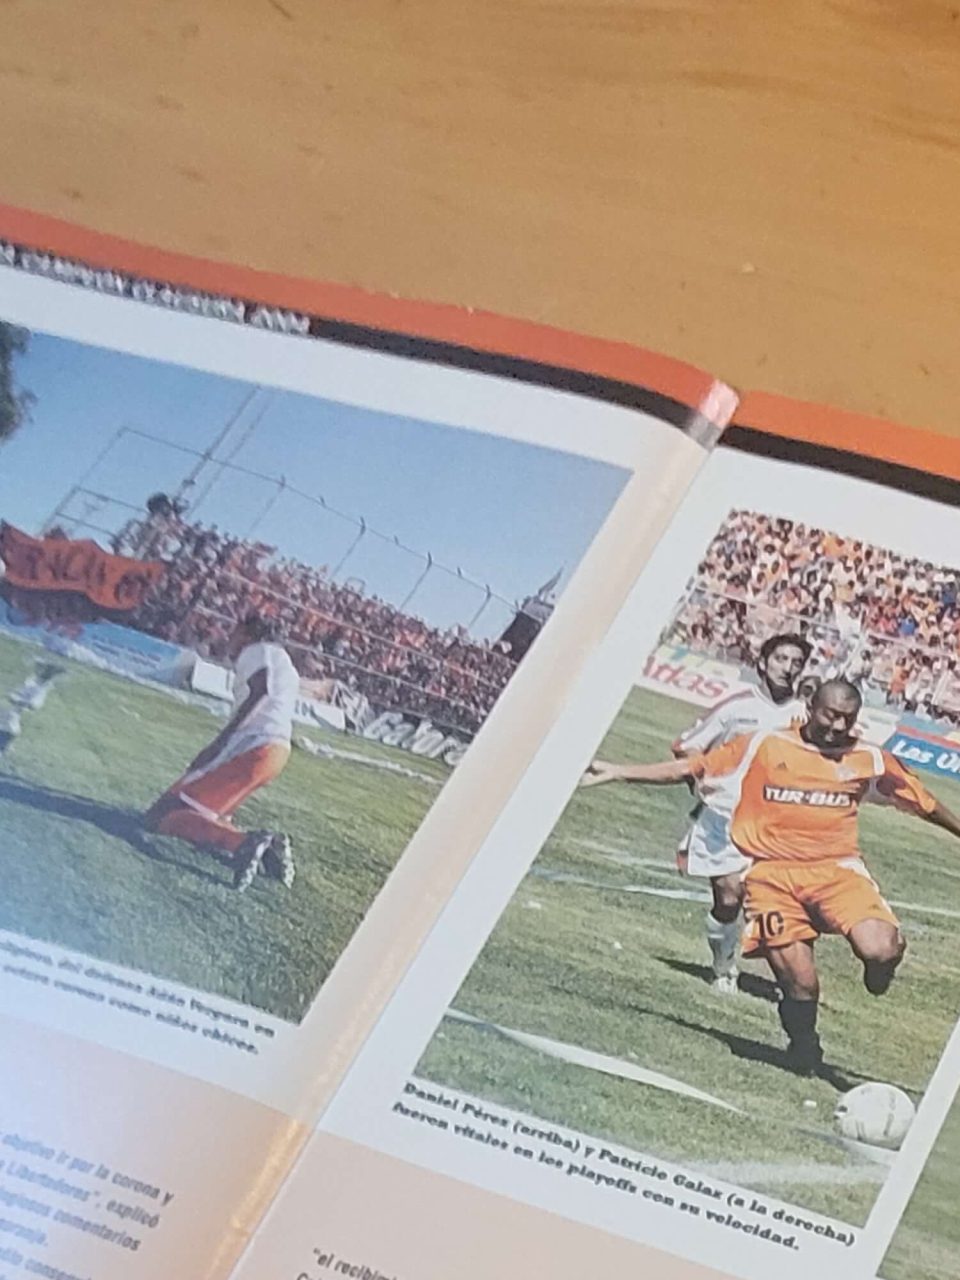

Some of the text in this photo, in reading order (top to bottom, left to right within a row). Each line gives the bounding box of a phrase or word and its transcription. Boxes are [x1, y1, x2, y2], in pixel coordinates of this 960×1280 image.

[892, 740, 933, 763] Las
[754, 911, 785, 938] 10
[392, 1101, 448, 1130] fueron
[454, 1124, 509, 1150] vitales
[538, 1150, 564, 1169] los
[566, 1162, 638, 1194] playoffs
[642, 1189, 674, 1207] con
[706, 1210, 799, 1250] velocidad.
[403, 1081, 459, 1111] Daniel
[462, 1102, 510, 1128] Pérez
[513, 1120, 580, 1154] (arriba)
[598, 1148, 668, 1180] Patricio
[673, 1174, 723, 1200] Galaz
[772, 1209, 855, 1247] derecha)
